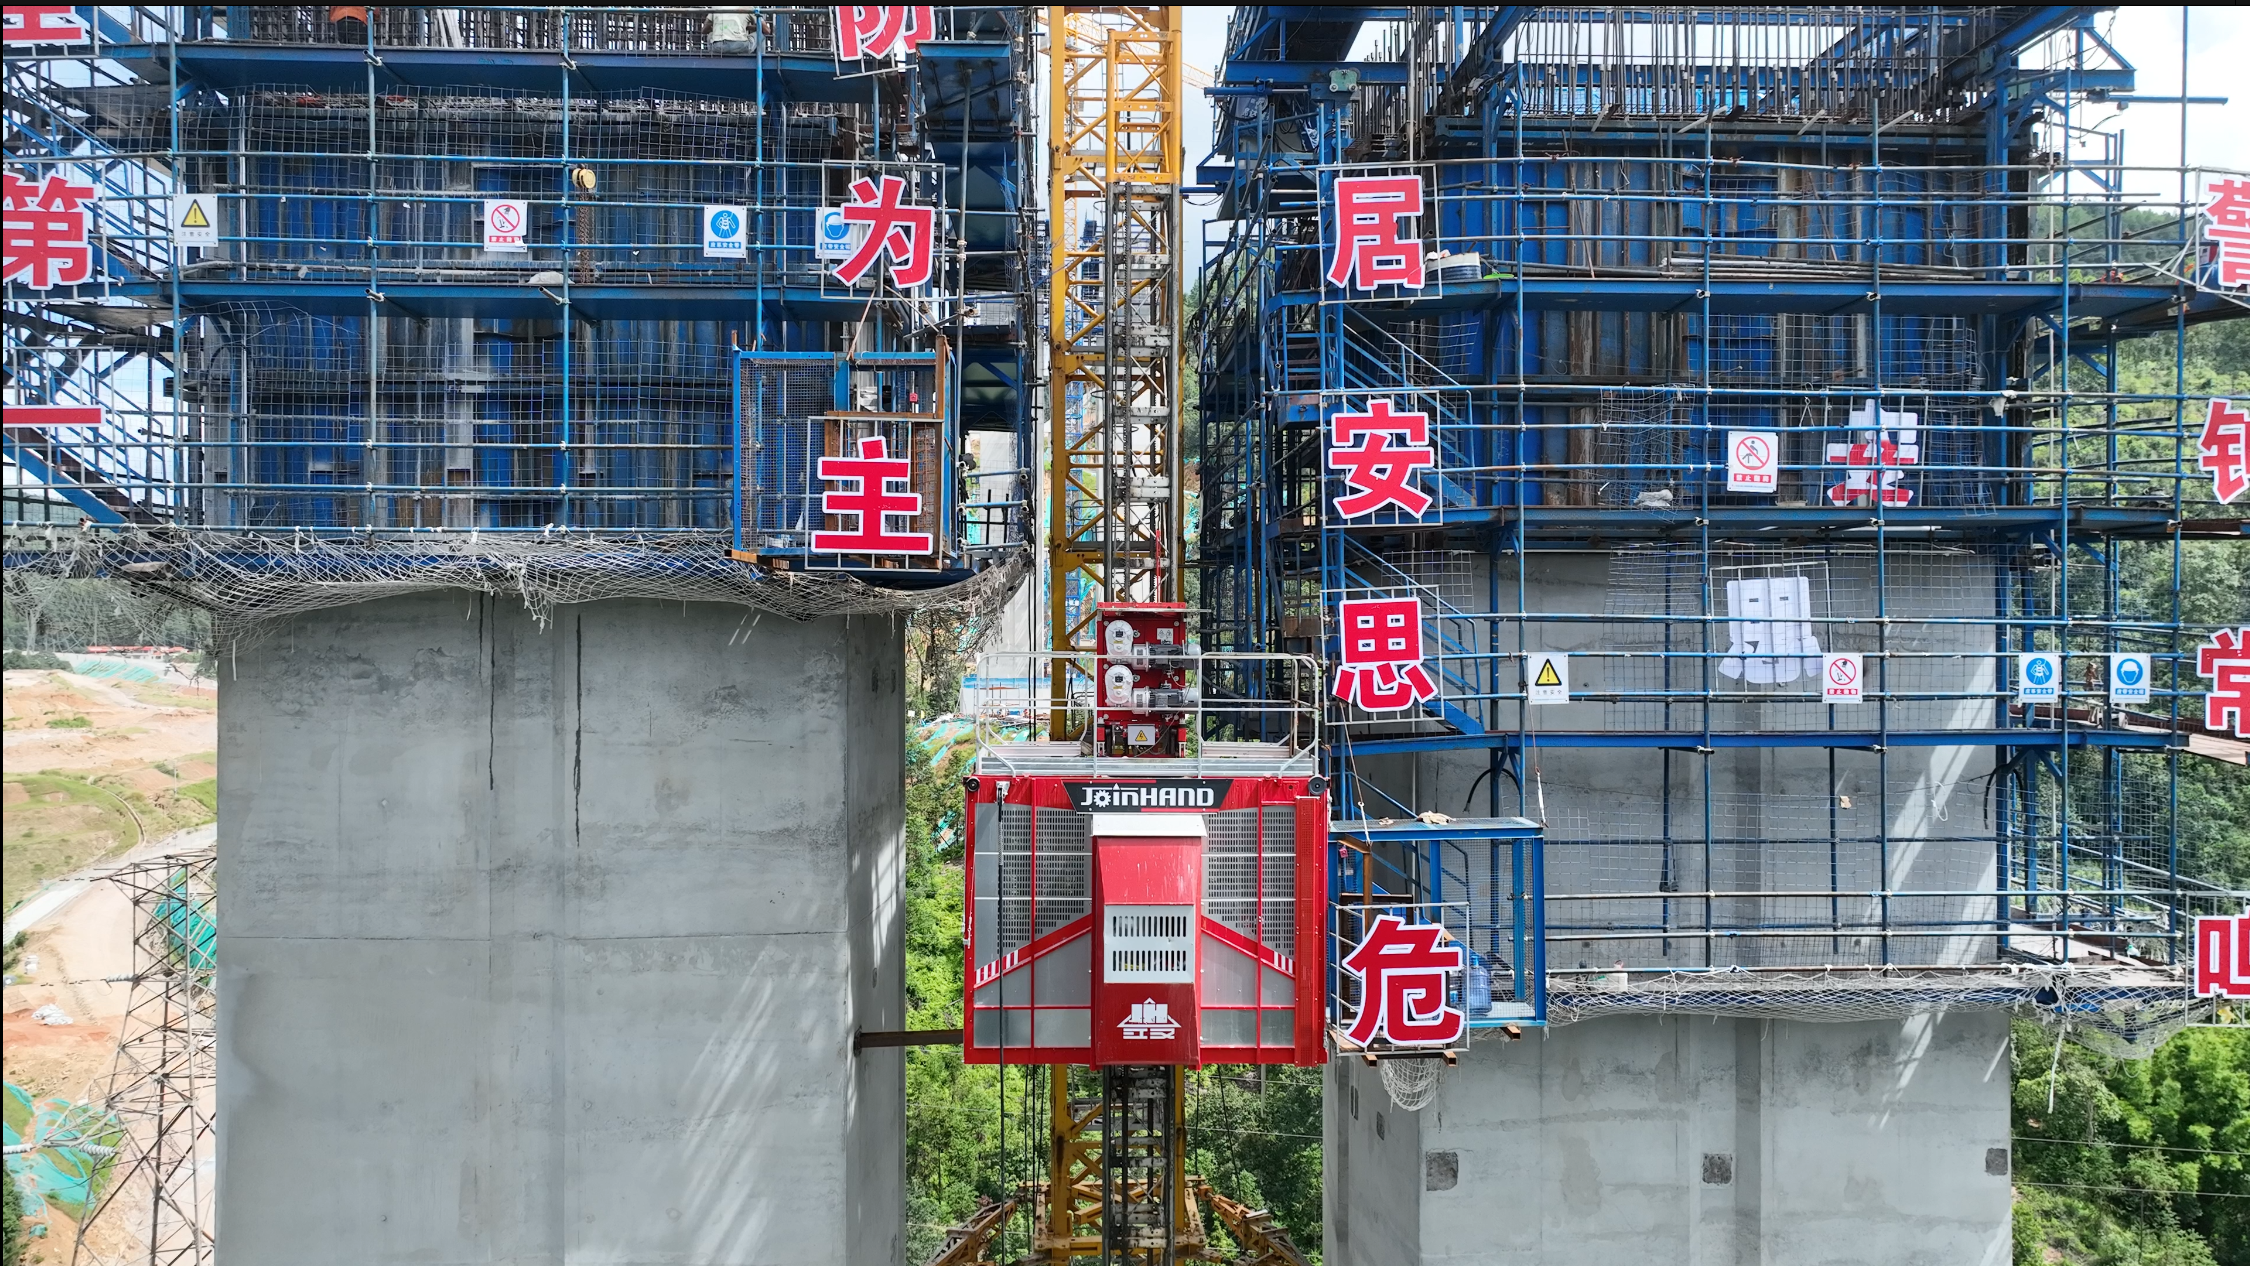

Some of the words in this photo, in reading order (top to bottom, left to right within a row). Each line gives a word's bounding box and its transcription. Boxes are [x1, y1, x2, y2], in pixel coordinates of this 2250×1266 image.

[3, 173, 95, 288] 第
[834, 176, 934, 287] 为
[1329, 177, 1423, 288] 居
[814, 438, 930, 553] 主
[1330, 401, 1432, 517] 安
[1334, 599, 1436, 710] 思
[1344, 916, 1463, 1044] 危
